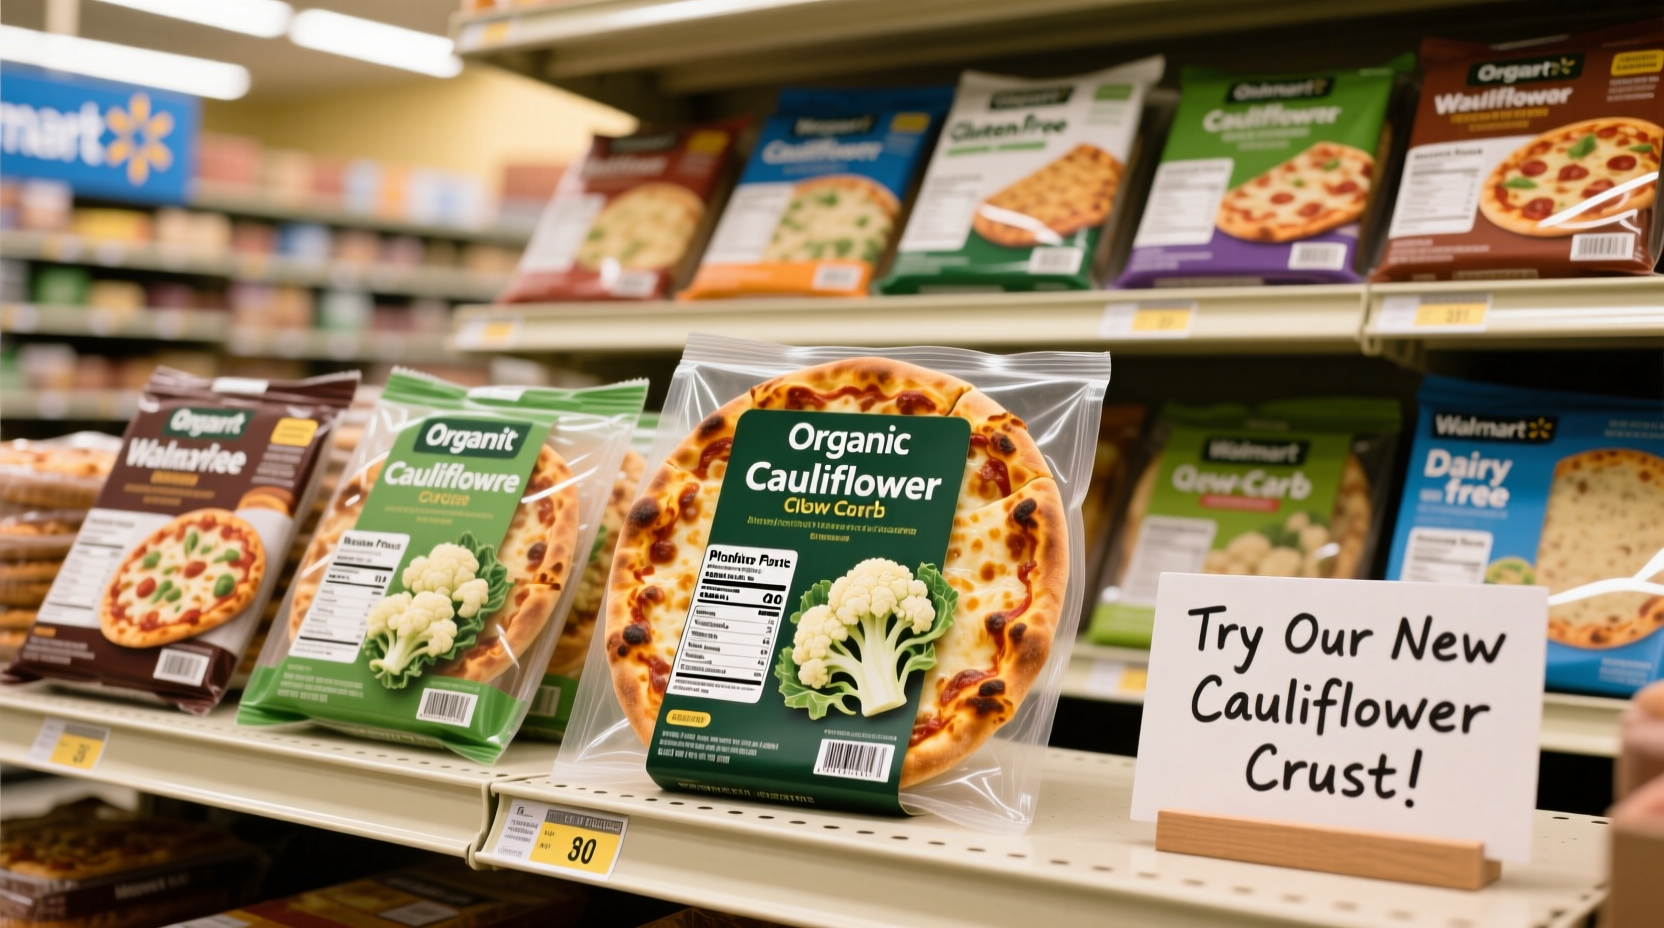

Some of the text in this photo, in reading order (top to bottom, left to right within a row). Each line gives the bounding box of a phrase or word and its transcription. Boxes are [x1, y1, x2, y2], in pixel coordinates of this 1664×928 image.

[788, 422, 911, 459] Organic
[1436, 414, 1526, 439] Walmart
[384, 461, 520, 493] Cauliflowre
[745, 461, 942, 500] Cauliflower
[1423, 448, 1513, 488] Dairy
[1445, 477, 1510, 508] free
[1188, 605, 1506, 674] Try Our New
[1191, 674, 1491, 736] Cauliflower
[1245, 743, 1423, 808] Crust!
